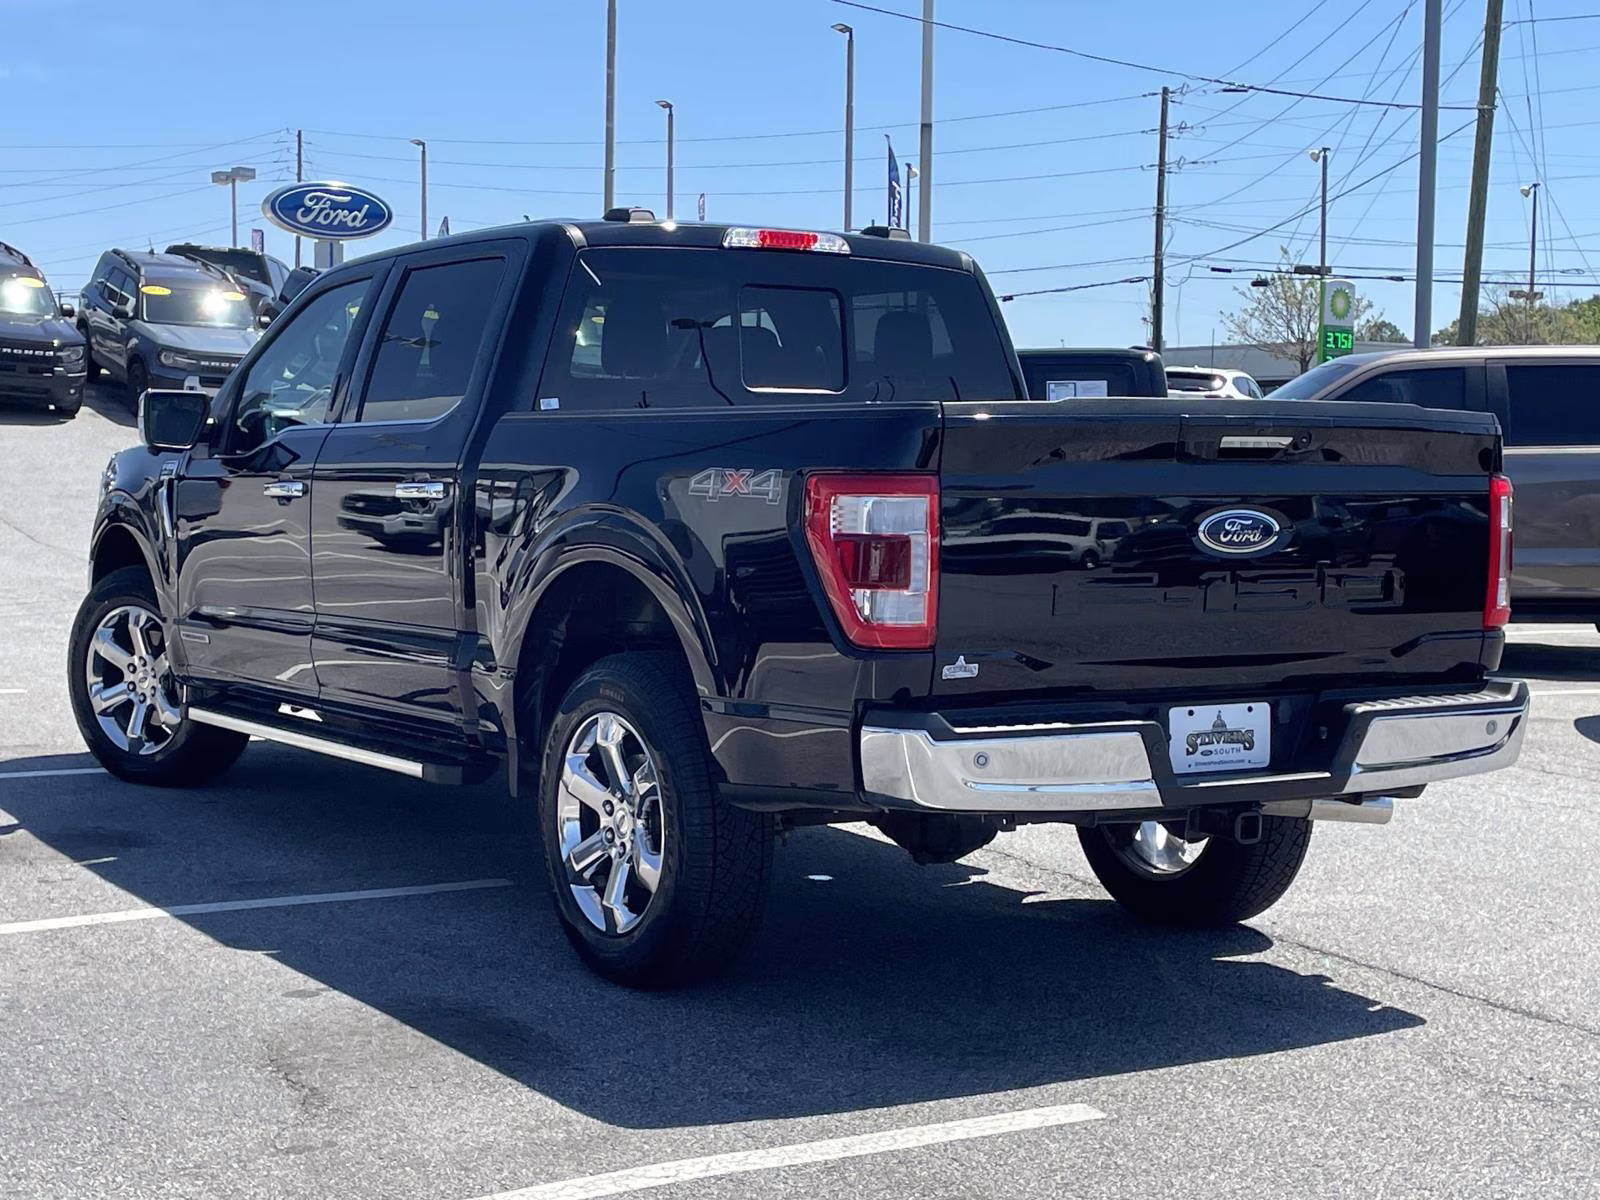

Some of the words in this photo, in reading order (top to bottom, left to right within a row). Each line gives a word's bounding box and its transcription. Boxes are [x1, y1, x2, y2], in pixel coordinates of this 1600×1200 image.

[296, 191, 369, 228] Ford
[0, 347, 54, 357] RONCO
[1220, 518, 1264, 543] Ford
[1213, 746, 1241, 756] SOUTH
